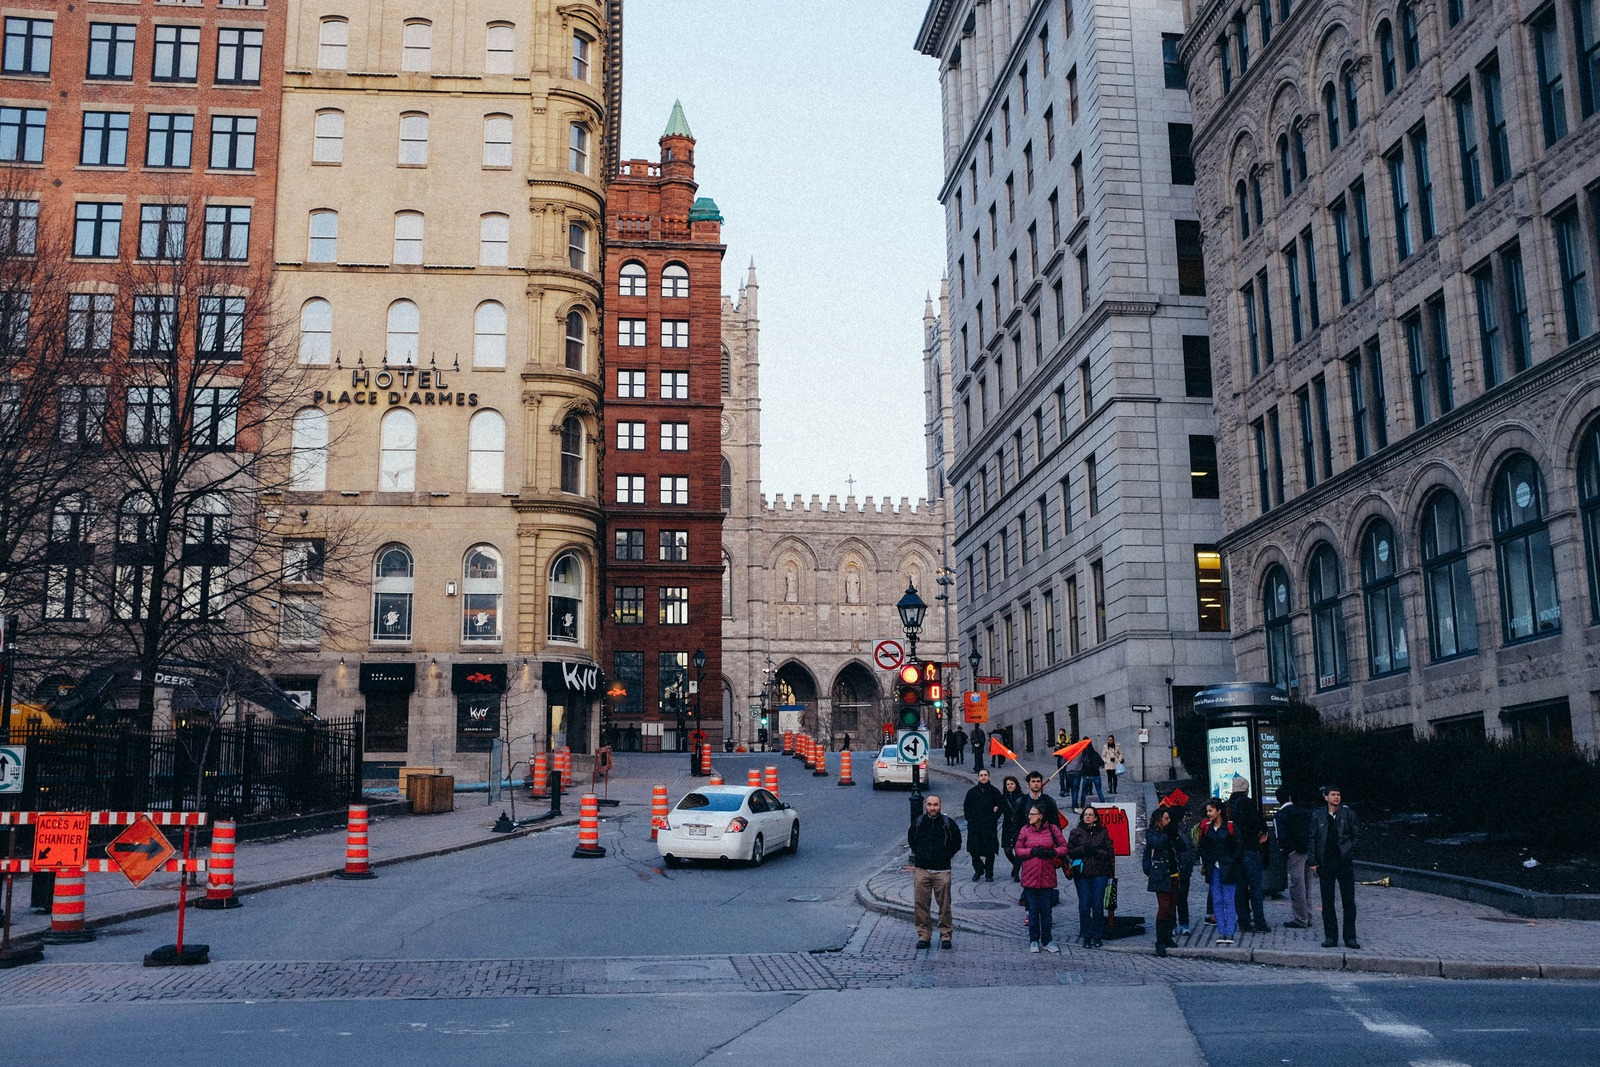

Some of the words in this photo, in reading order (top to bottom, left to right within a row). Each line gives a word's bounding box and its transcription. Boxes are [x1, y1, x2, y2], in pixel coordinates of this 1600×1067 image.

[352, 370, 448, 389] HOTEL
[313, 390, 378, 405] PLACE
[388, 391, 478, 406] D'ARMES
[154, 672, 194, 687] DEERE
[1232, 736, 1246, 744] pas
[1260, 733, 1274, 741] Une
[1264, 768, 1271, 776] le
[1100, 814, 1124, 824] TOUR
[72, 820, 84, 830] AU
[38, 834, 82, 845] CHANTIER
[73, 848, 78, 862] 1
